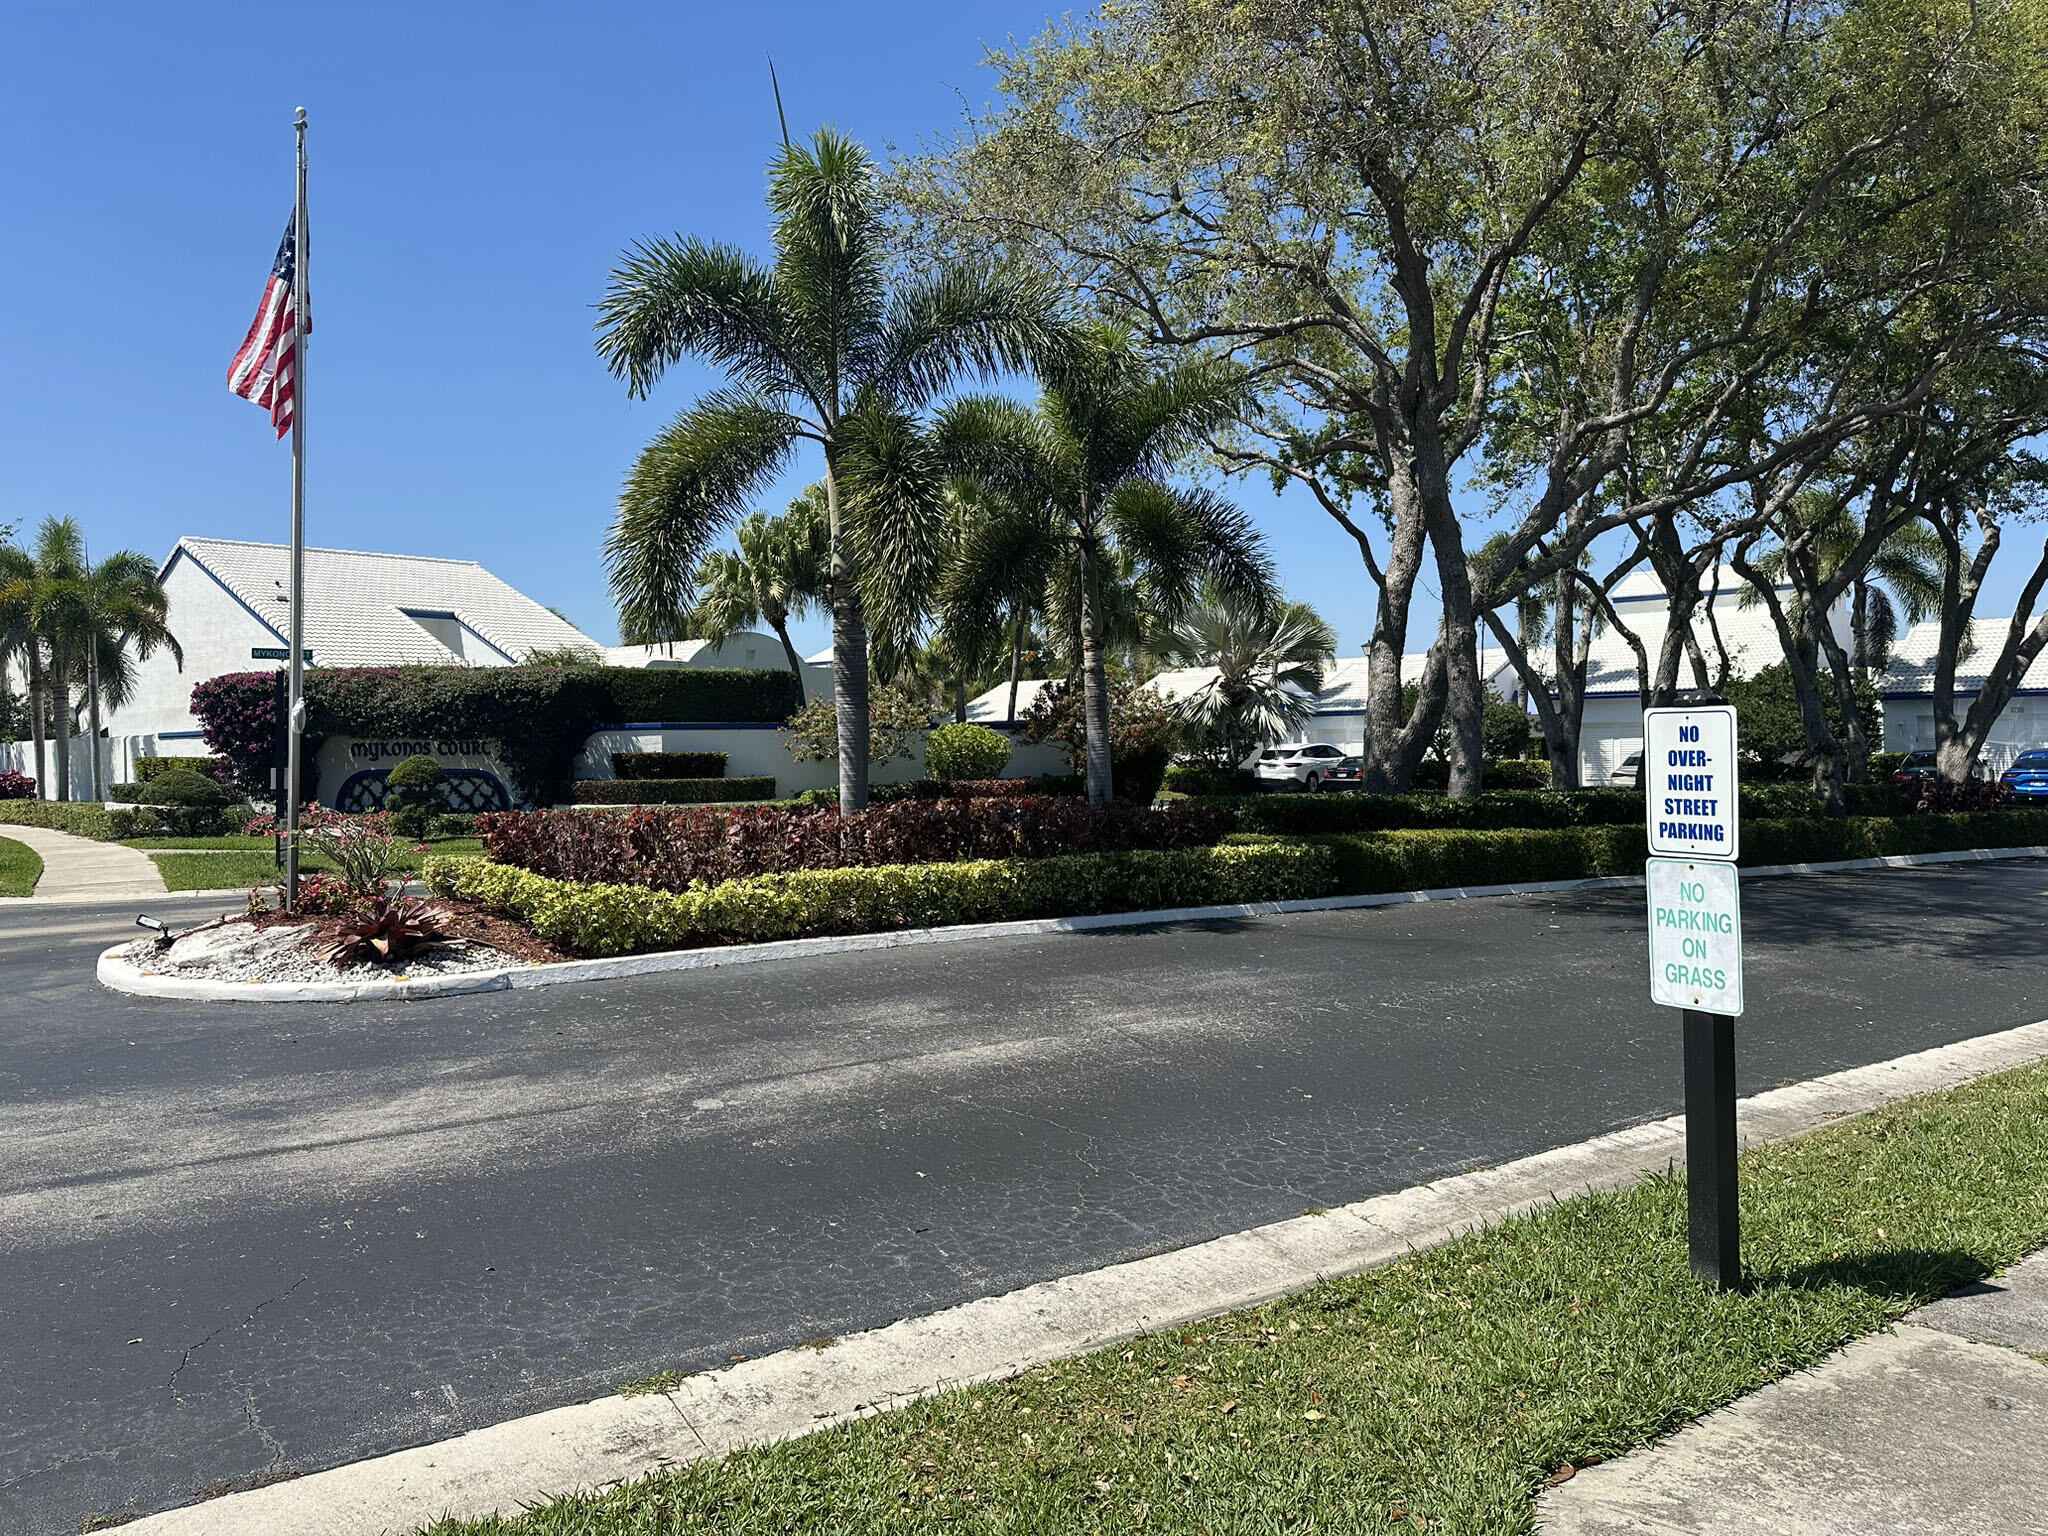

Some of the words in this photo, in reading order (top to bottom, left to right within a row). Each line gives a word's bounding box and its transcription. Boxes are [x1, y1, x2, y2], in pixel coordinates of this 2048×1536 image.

[1679, 726, 1700, 743] NO
[1668, 750, 1712, 767] OVER-
[1668, 774, 1714, 792] NIGHT
[1665, 798, 1718, 816] STREET
[1659, 822, 1724, 842] PARKING
[1680, 882, 1705, 903] NO
[1656, 907, 1732, 934] PARKING
[1682, 939, 1707, 960] ON
[1665, 963, 1726, 990] GRASS
